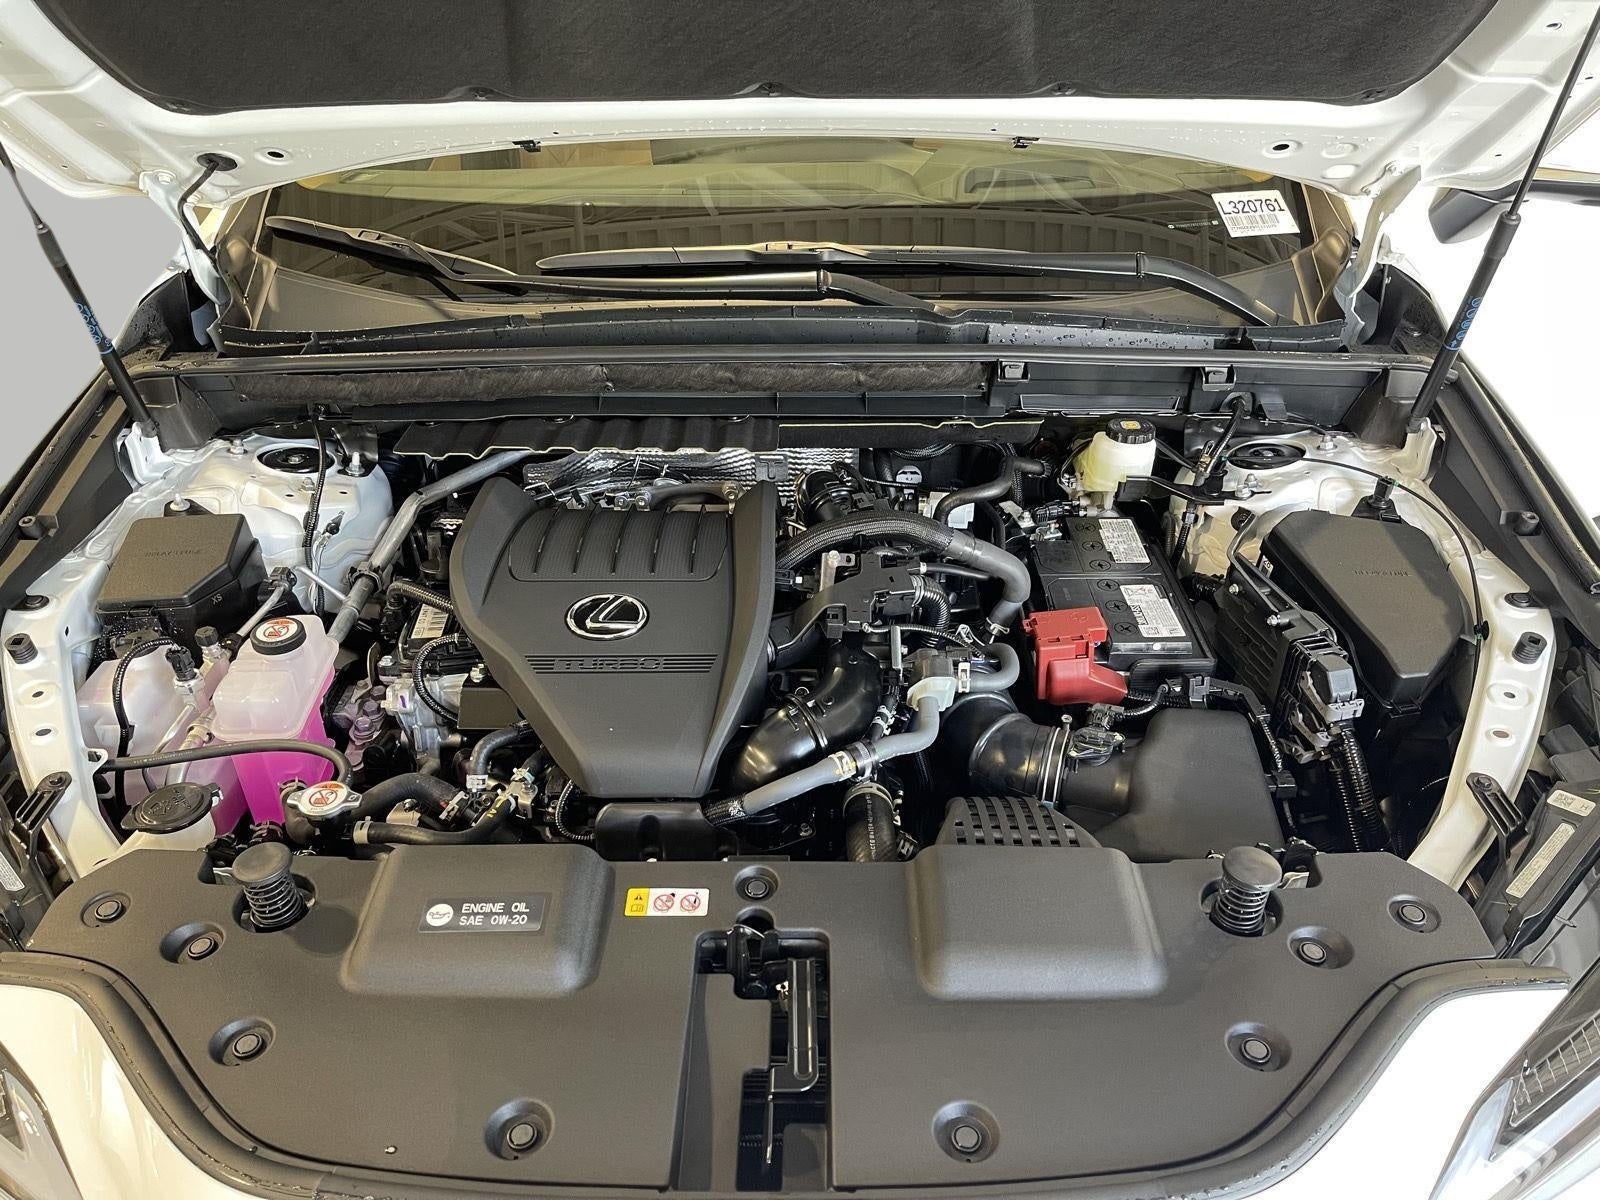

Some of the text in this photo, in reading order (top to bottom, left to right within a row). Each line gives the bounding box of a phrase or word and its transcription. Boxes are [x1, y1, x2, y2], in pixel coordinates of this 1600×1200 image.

[1218, 198, 1285, 215] L320761
[556, 657, 661, 671] TURBO
[461, 902, 530, 914] ENGINE OIL
[458, 914, 528, 926] SAE 0W-20
